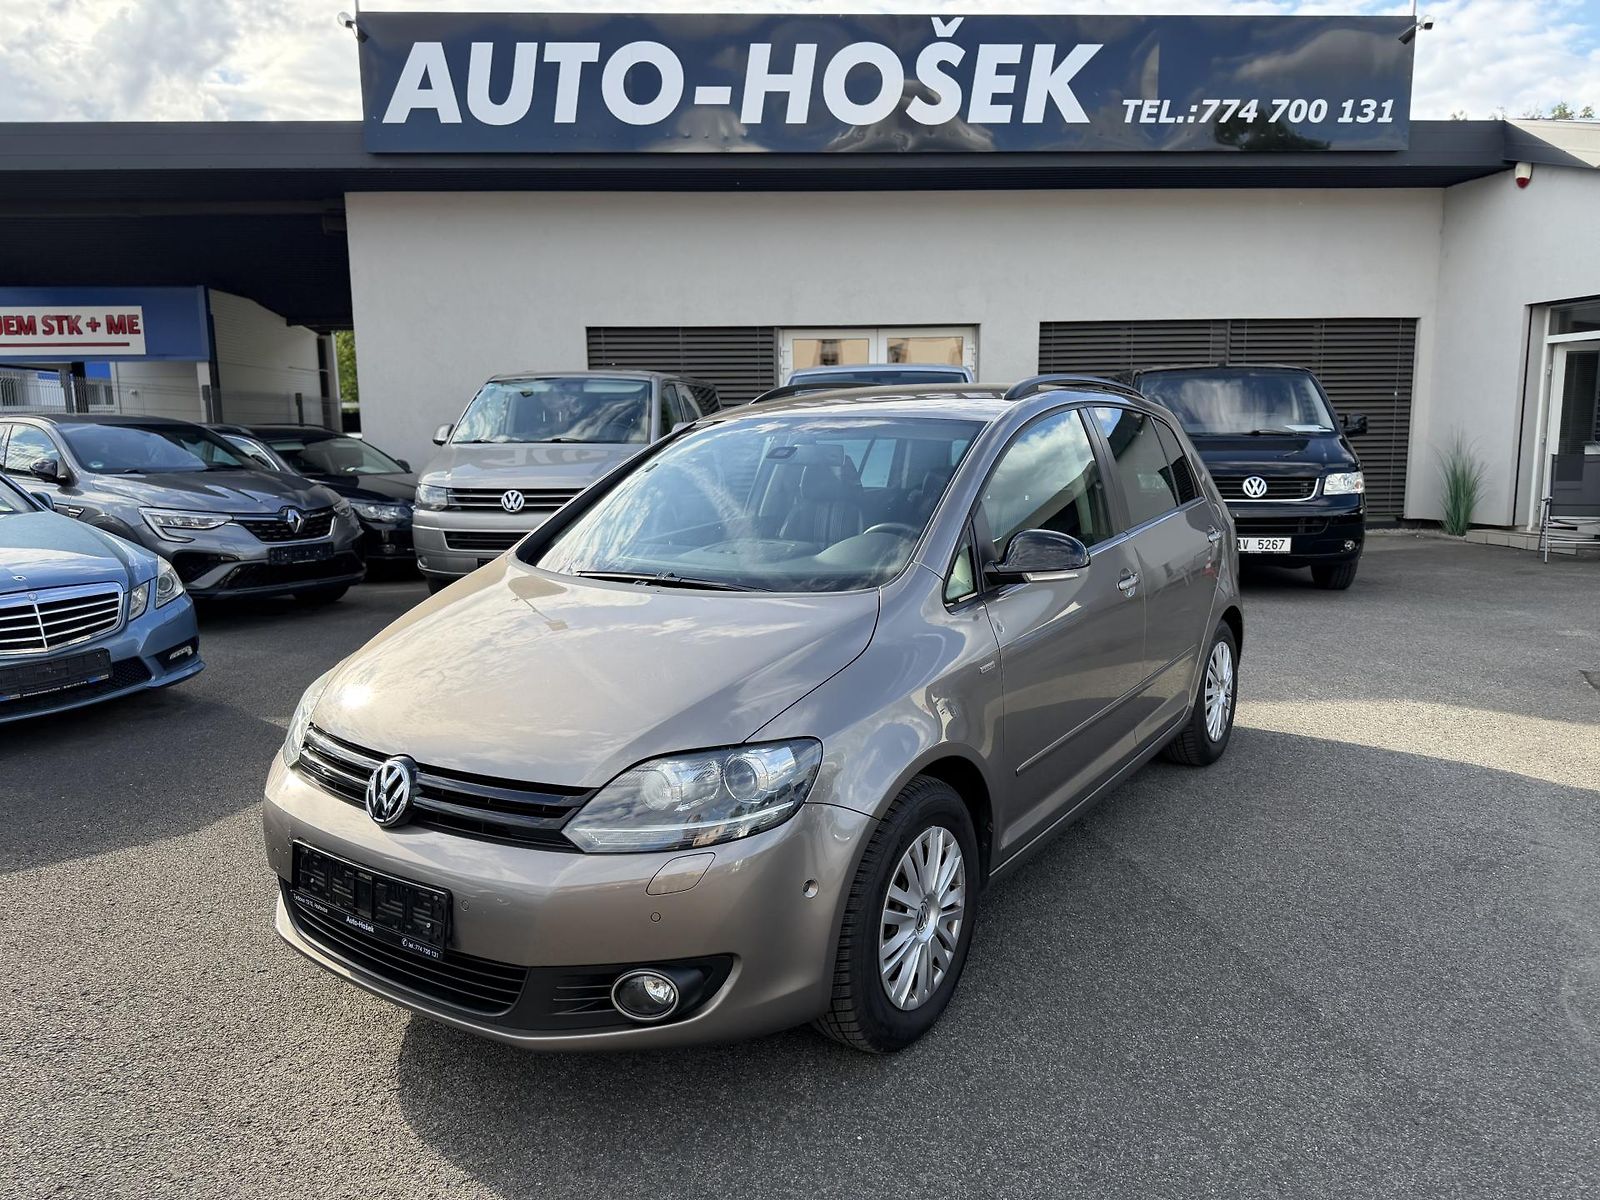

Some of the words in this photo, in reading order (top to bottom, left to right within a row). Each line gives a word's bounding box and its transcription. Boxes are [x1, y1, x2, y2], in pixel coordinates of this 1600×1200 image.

[382, 17, 1103, 125] AUTO-HOŠEK
[1122, 99, 1258, 124] TEL.:774
[1267, 99, 1328, 124] 700
[1337, 99, 1394, 124] 131
[41, 315, 83, 335] STK
[105, 314, 141, 335] ME
[1258, 539, 1286, 550] 5267
